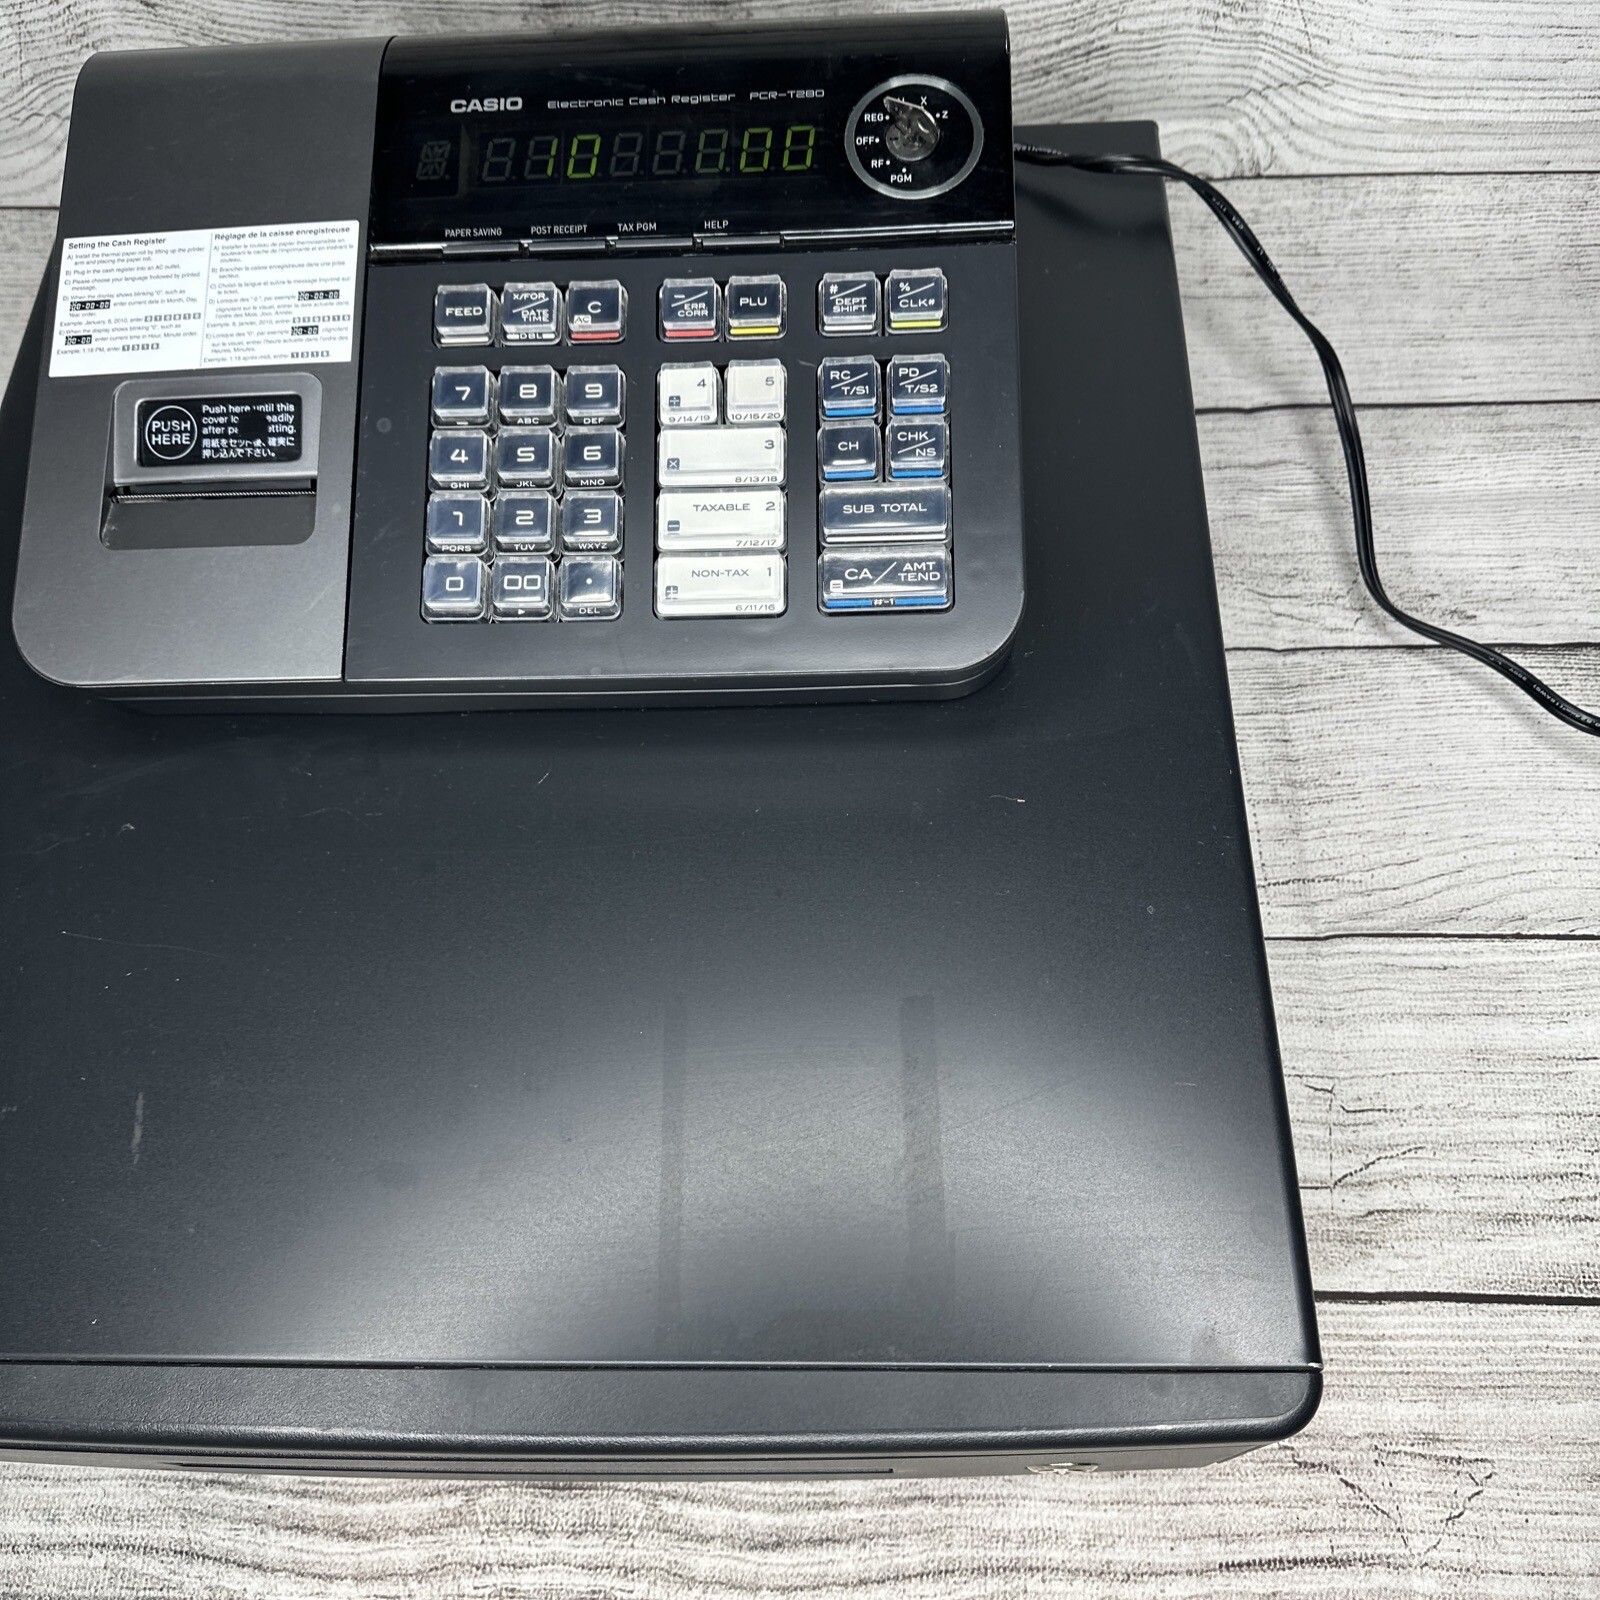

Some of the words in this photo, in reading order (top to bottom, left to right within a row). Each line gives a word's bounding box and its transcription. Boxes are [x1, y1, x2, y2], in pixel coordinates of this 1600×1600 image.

[450, 97, 523, 113] CASIO
[547, 98, 624, 110] Electronic
[629, 95, 666, 106] Cash
[671, 93, 736, 106] Register
[749, 89, 825, 101] PCR-T280
[920, 96, 928, 106] X
[864, 113, 884, 122] REG
[942, 111, 949, 119] Z
[856, 137, 875, 146] OFF
[871, 159, 884, 168] RF
[890, 174, 912, 183] PGM
[530, 225, 552, 235] POST
[553, 224, 588, 234] RECEIPT
[617, 223, 635, 232] TAX
[636, 222, 657, 232] PGM
[704, 220, 729, 230] HELP
[214, 231, 245, 241] Réglage
[268, 229, 293, 237] caisse
[296, 226, 349, 236] enregistreuse
[445, 228, 471, 237] PAPER
[473, 227, 502, 237] SAVING
[68, 241, 95, 250] Setting
[111, 239, 131, 247] Cash
[133, 237, 166, 247] Register
[829, 284, 838, 294] #
[899, 282, 910, 292] %
[513, 292, 546, 300] X/FOR
[835, 297, 867, 305] DEPT
[739, 297, 767, 306] PLU
[899, 299, 935, 308] CLK#
[445, 306, 483, 316] FEED
[587, 301, 602, 313] C
[833, 305, 867, 313] SHIFT
[830, 370, 851, 380] RC
[899, 368, 919, 377] PD
[697, 378, 706, 388] 4
[765, 377, 775, 386] 5
[455, 386, 471, 401] 7
[519, 383, 537, 399] 8
[585, 383, 602, 399] 9
[841, 385, 869, 395] T/S1
[905, 384, 938, 393] T/S2
[202, 404, 226, 414] Push
[228, 404, 250, 413] here
[276, 402, 295, 412] this
[202, 415, 228, 425] cover
[266, 413, 294, 425] eadily
[669, 415, 710, 423] 9/14/19
[731, 412, 780, 420] 10/15/20
[152, 420, 191, 433] PUSH
[202, 426, 225, 436] after
[152, 434, 191, 446] HERE
[897, 431, 929, 441] CHK
[764, 439, 775, 450] 3
[838, 442, 859, 451] CH
[450, 449, 468, 463] 4
[517, 447, 535, 462] 5
[583, 446, 601, 461] 6
[915, 448, 936, 457] NS
[693, 503, 750, 512] TAXABLE
[765, 502, 775, 511] 2
[843, 504, 874, 513] SUB
[881, 503, 927, 512] TOTAL
[453, 511, 463, 526] 1
[515, 510, 534, 525] 2
[583, 509, 601, 524] 3
[903, 562, 936, 571] AMT
[691, 569, 749, 577] NON-TAX
[767, 567, 772, 576] 1
[844, 568, 873, 580] CA
[898, 572, 941, 581] TEND
